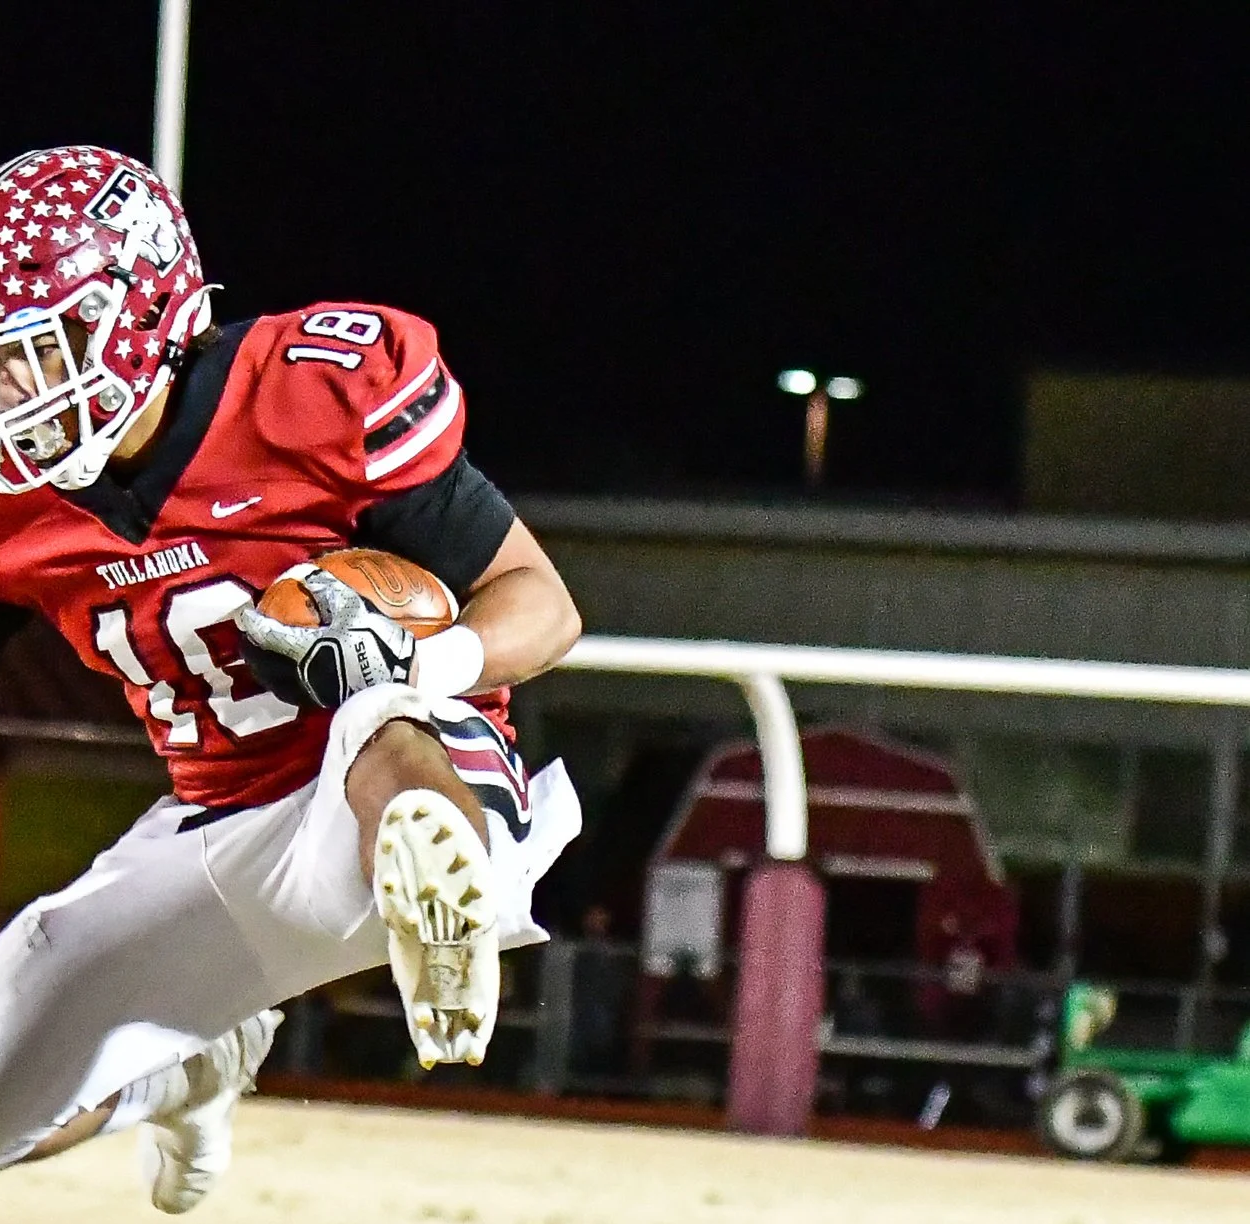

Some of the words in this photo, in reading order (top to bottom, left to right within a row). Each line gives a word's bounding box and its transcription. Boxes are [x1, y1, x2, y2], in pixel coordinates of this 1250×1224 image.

[286, 310, 383, 370] 18
[95, 541, 210, 590] TULLAHOMA
[354, 640, 376, 688] TTERS
